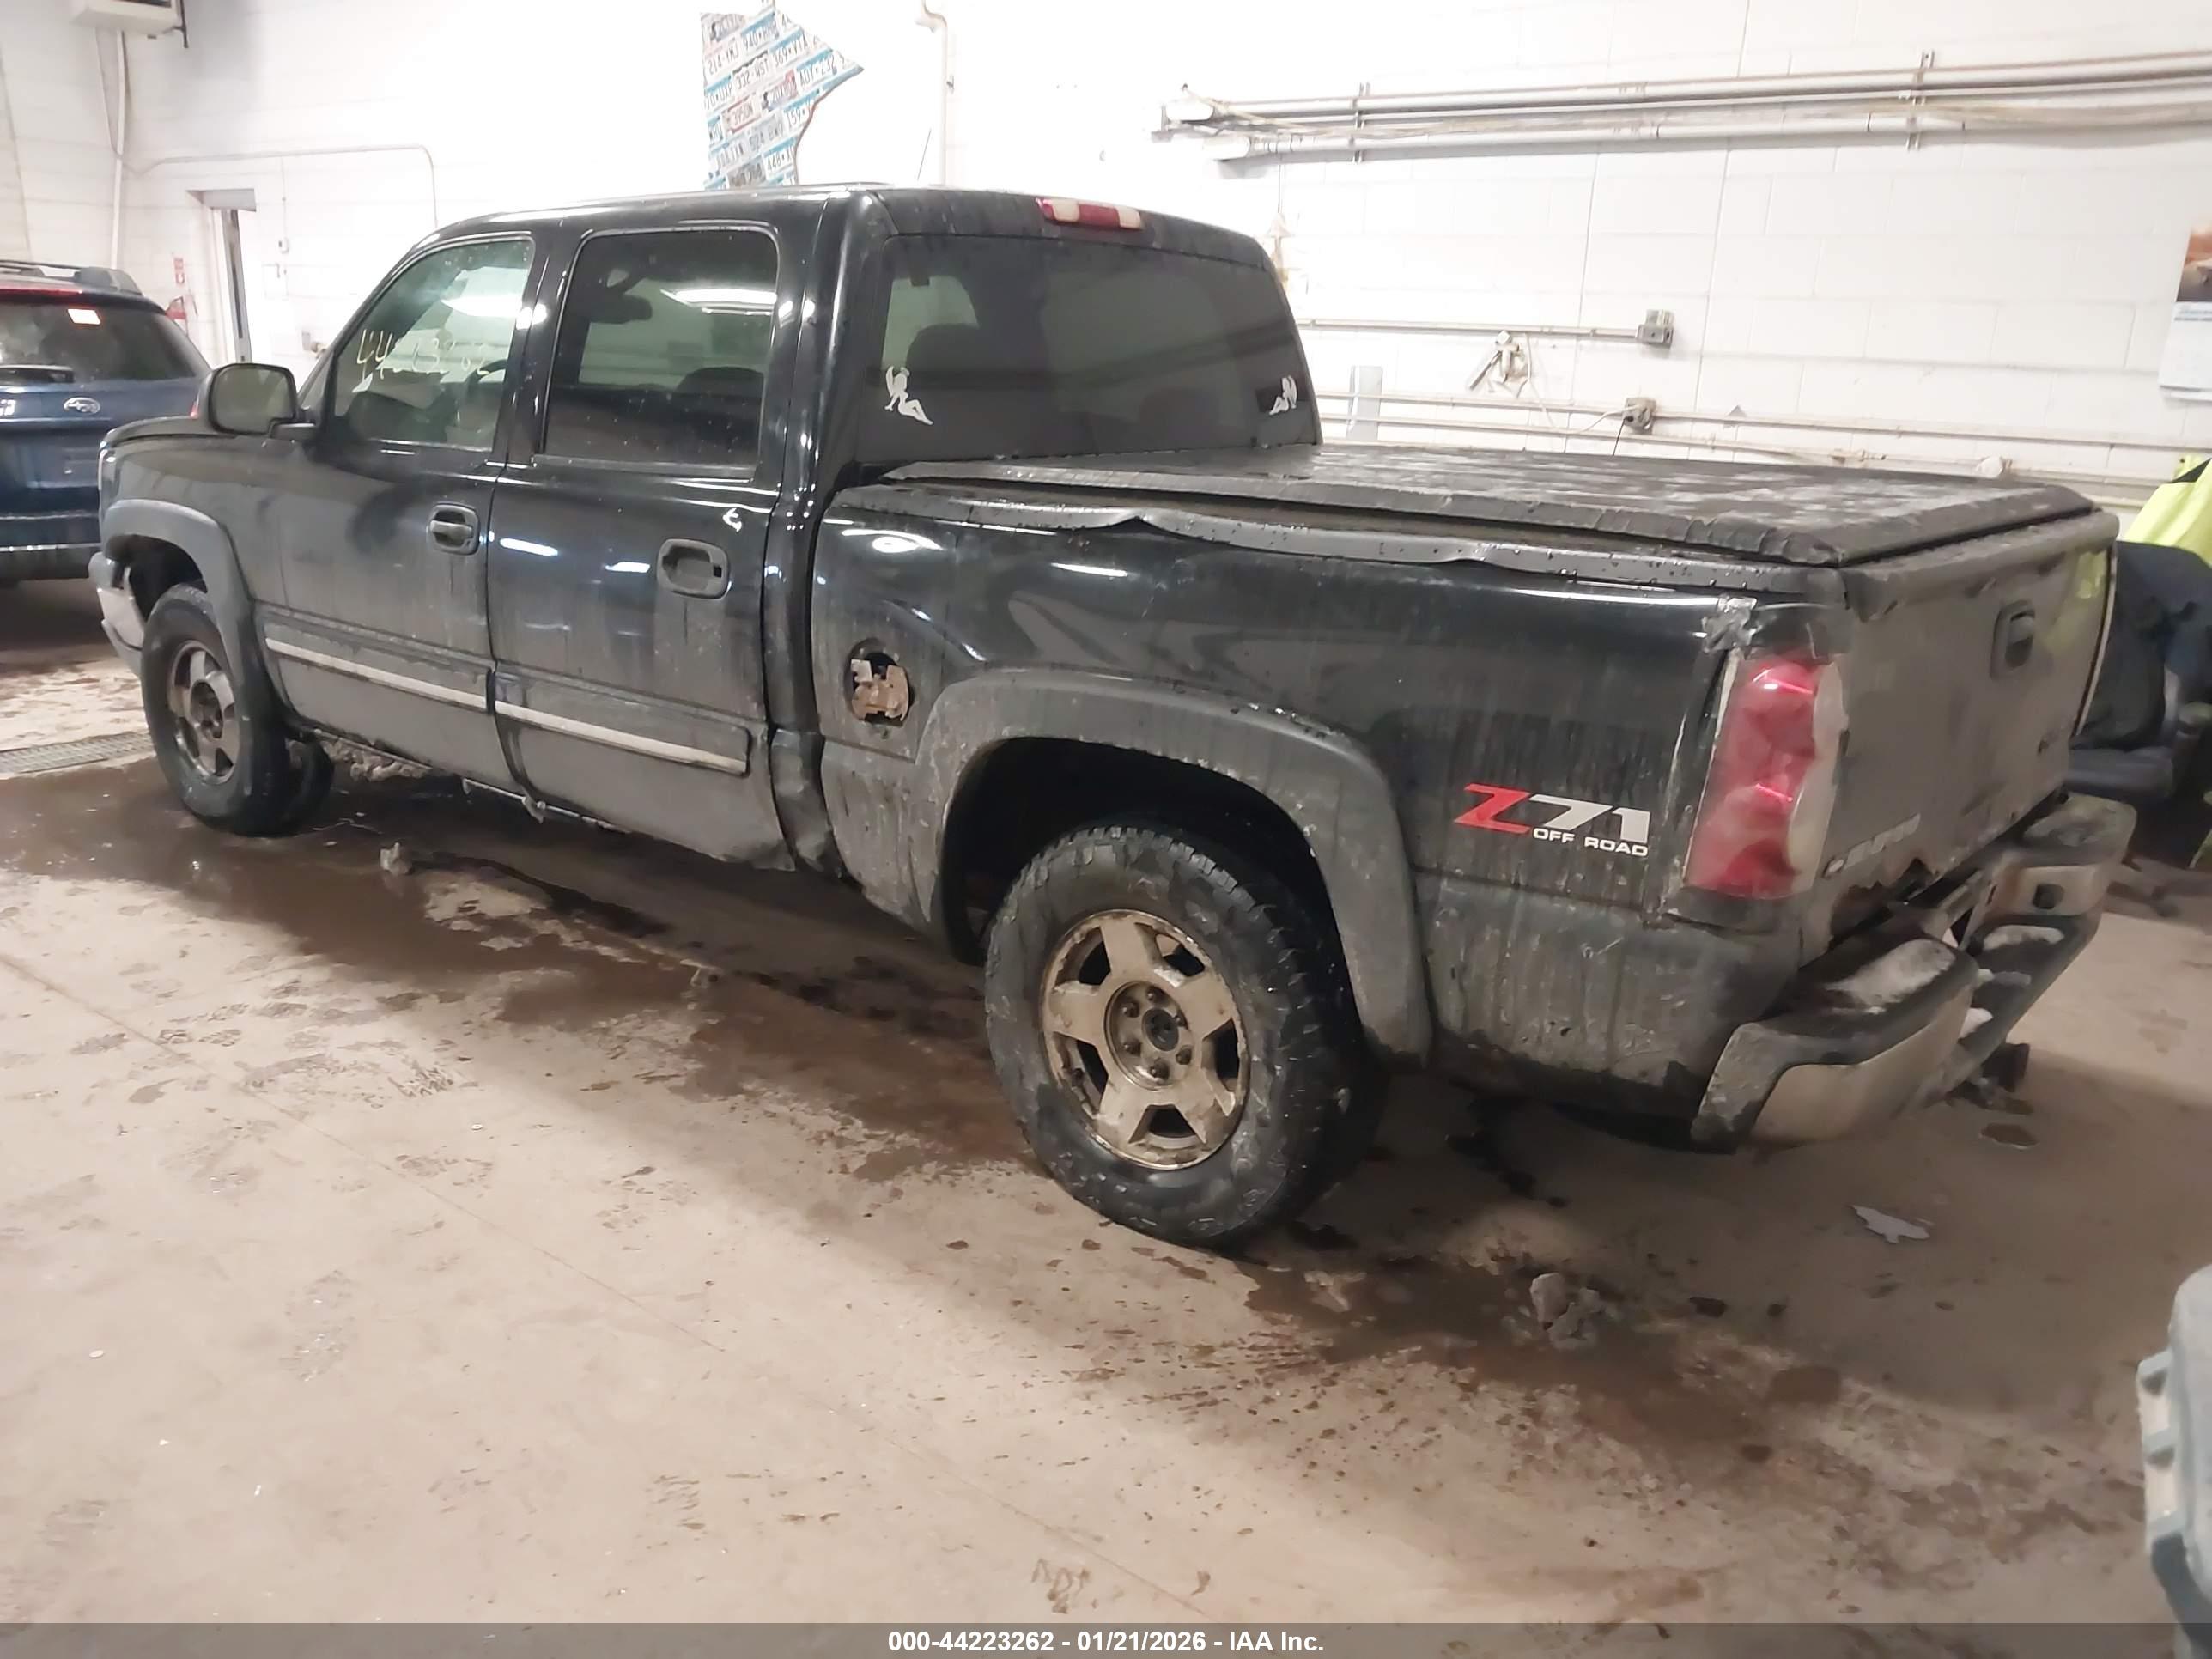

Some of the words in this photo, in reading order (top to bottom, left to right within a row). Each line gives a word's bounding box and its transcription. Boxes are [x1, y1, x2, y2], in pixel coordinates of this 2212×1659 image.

[1454, 782, 1650, 843] Z71
[1533, 827, 1575, 844] OFF
[1584, 836, 1649, 857] ROAD
